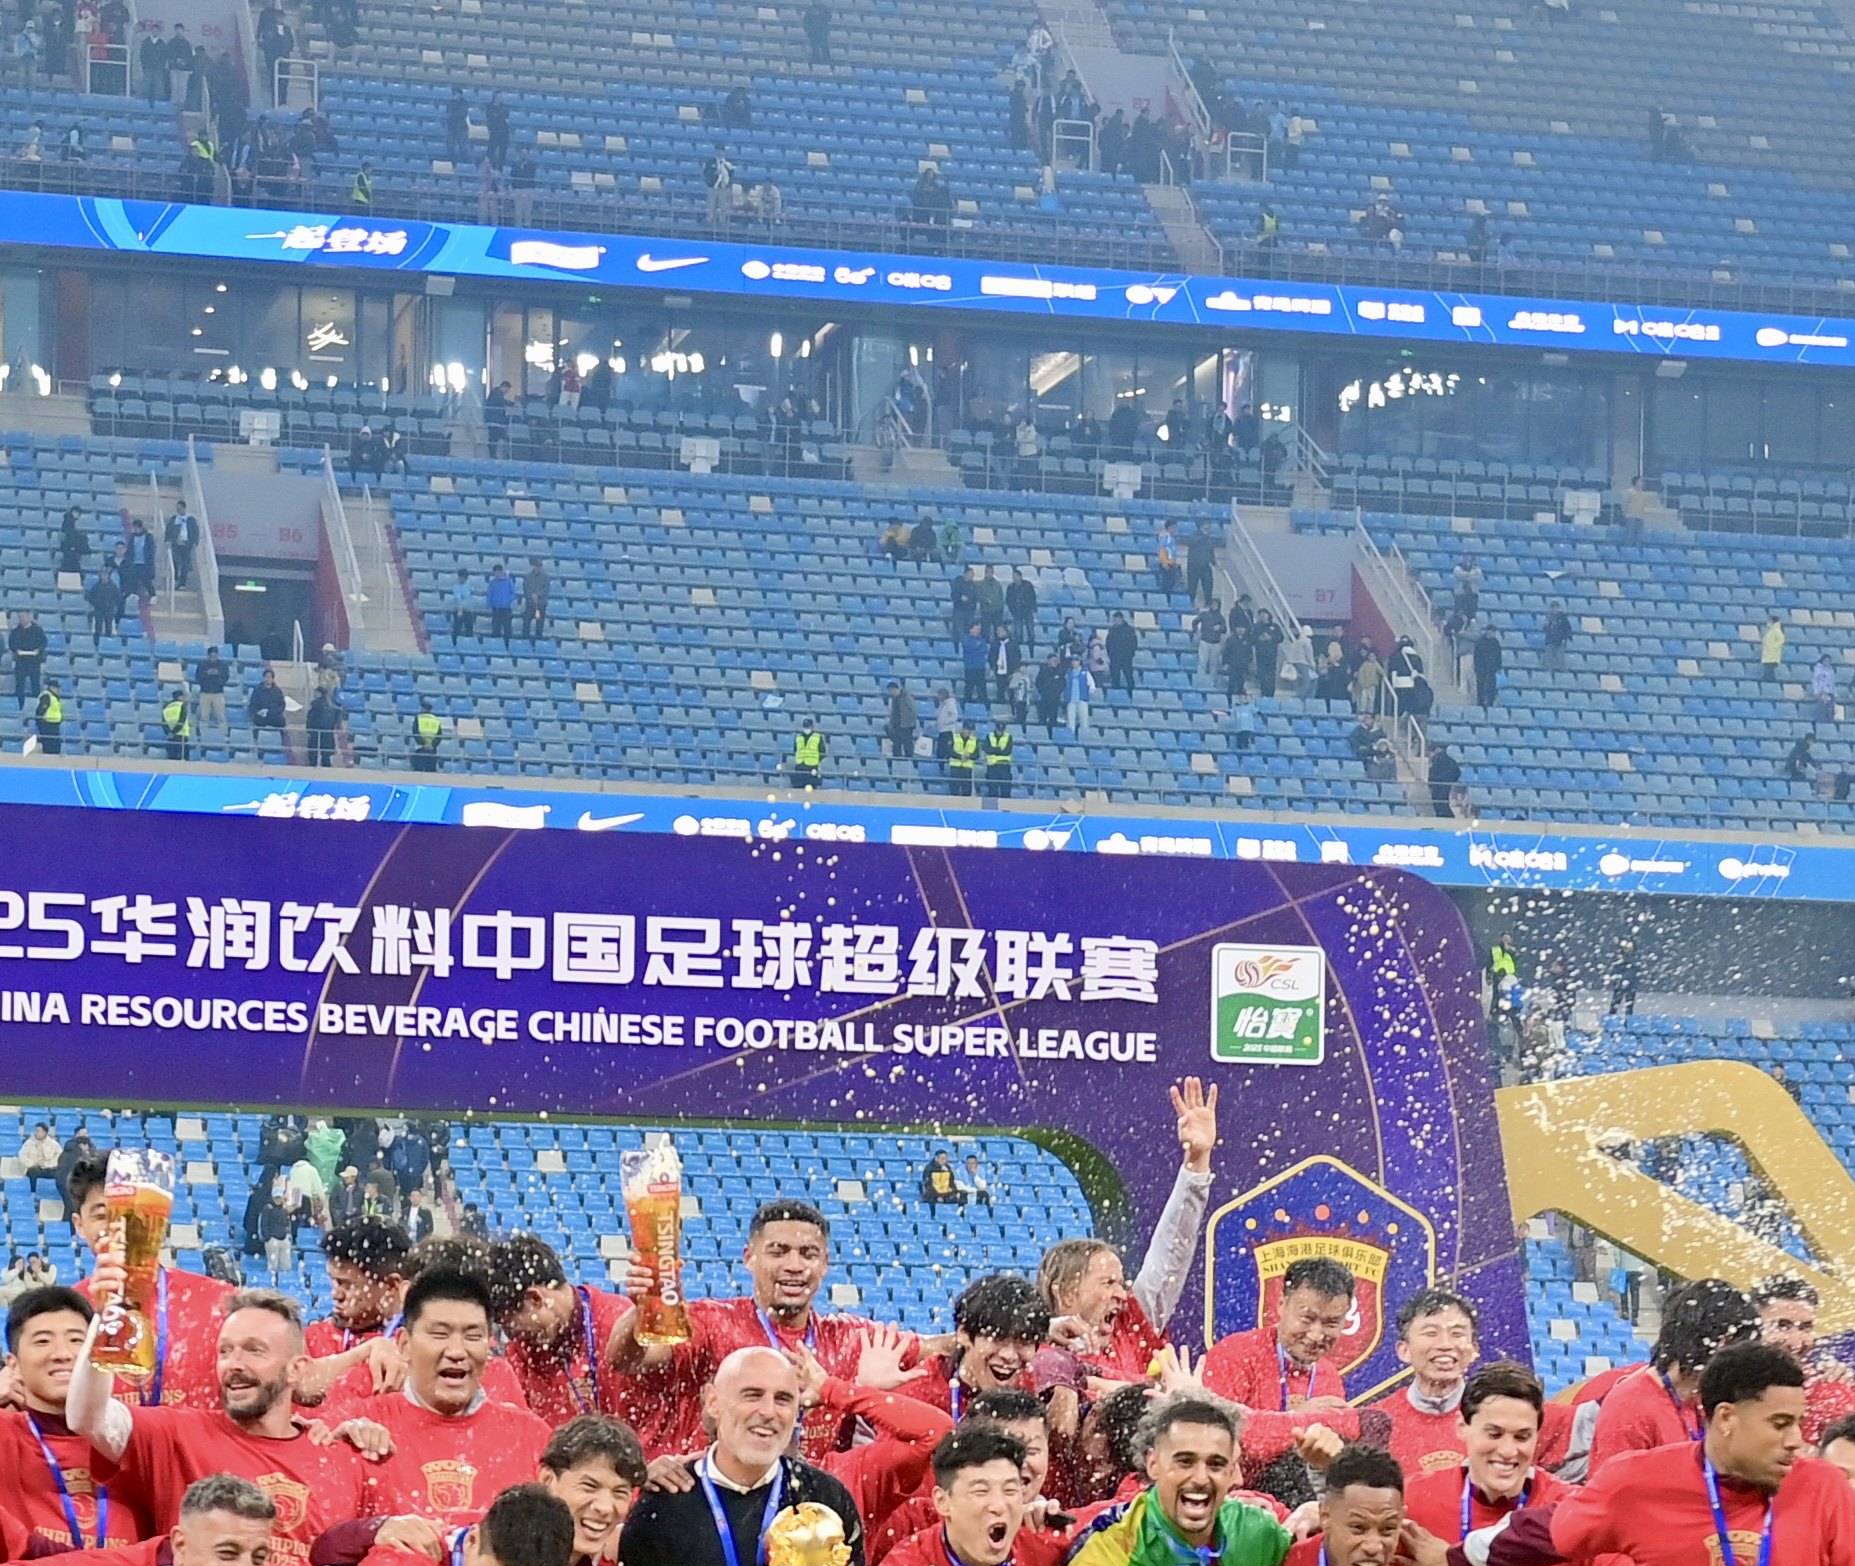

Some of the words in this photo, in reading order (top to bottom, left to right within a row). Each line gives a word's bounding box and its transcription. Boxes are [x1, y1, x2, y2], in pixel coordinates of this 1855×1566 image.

[1270, 978, 1300, 991] CSL
[79, 993, 309, 1035] RESOURCES
[318, 1004, 519, 1044] BEVERAGE
[528, 1009, 684, 1048] CHINESE
[694, 1015, 884, 1055] FOOTBALL
[893, 1020, 1011, 1059] SUPER
[1018, 1025, 1157, 1064] LEAGUE
[657, 1211, 681, 1307] TSINGTAO
[271, 1552, 299, 1566] 025
